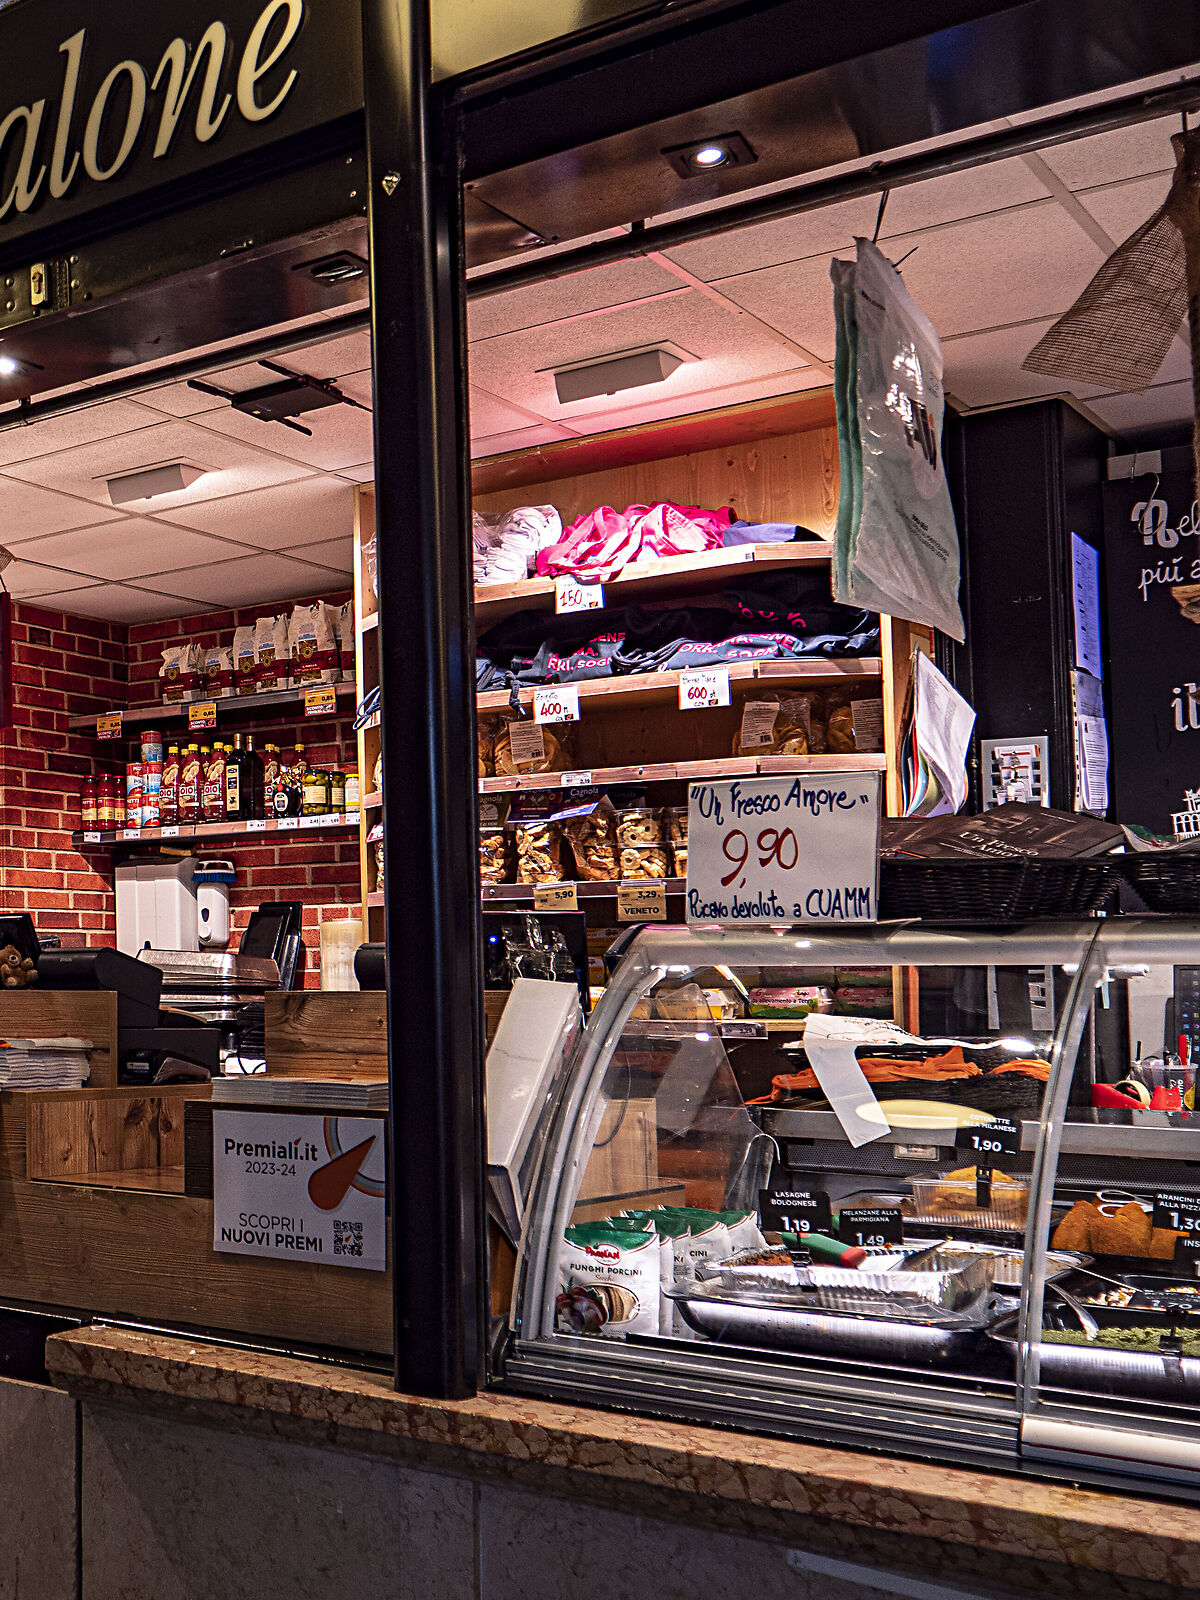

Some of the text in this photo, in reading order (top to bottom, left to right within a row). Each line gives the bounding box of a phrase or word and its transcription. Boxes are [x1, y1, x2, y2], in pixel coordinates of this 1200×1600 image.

[1138, 556, 1184, 602] più
[688, 686, 708, 699] 600
[541, 703, 562, 716] 400
[570, 786, 599, 798] Cagnola
[729, 781, 781, 818] Fresco
[720, 826, 799, 889] 9,90
[554, 890, 573, 899] 5,90
[731, 889, 785, 918] devoluto
[793, 902, 801, 918] a
[805, 886, 871, 920] CUAMM
[624, 907, 660, 915] VENETO
[970, 1114, 1011, 1125] COTOLETTE
[982, 1123, 1017, 1133] MILANESE
[971, 1136, 1003, 1152] 1,90
[245, 1160, 297, 1177] 2023-24
[775, 1191, 811, 1199] LASAGNE
[1157, 1193, 1196, 1203] ARANCINI
[771, 1199, 818, 1207] BOLOGNESE
[1159, 1201, 1180, 1209] ALLA
[239, 1212, 296, 1232] SCOPRI
[781, 1216, 811, 1233] 1,19
[221, 1227, 324, 1253] NUOVI PREMI
[856, 1232, 885, 1247] 1,49
[569, 1263, 643, 1277] FUNGHI PORCINI
